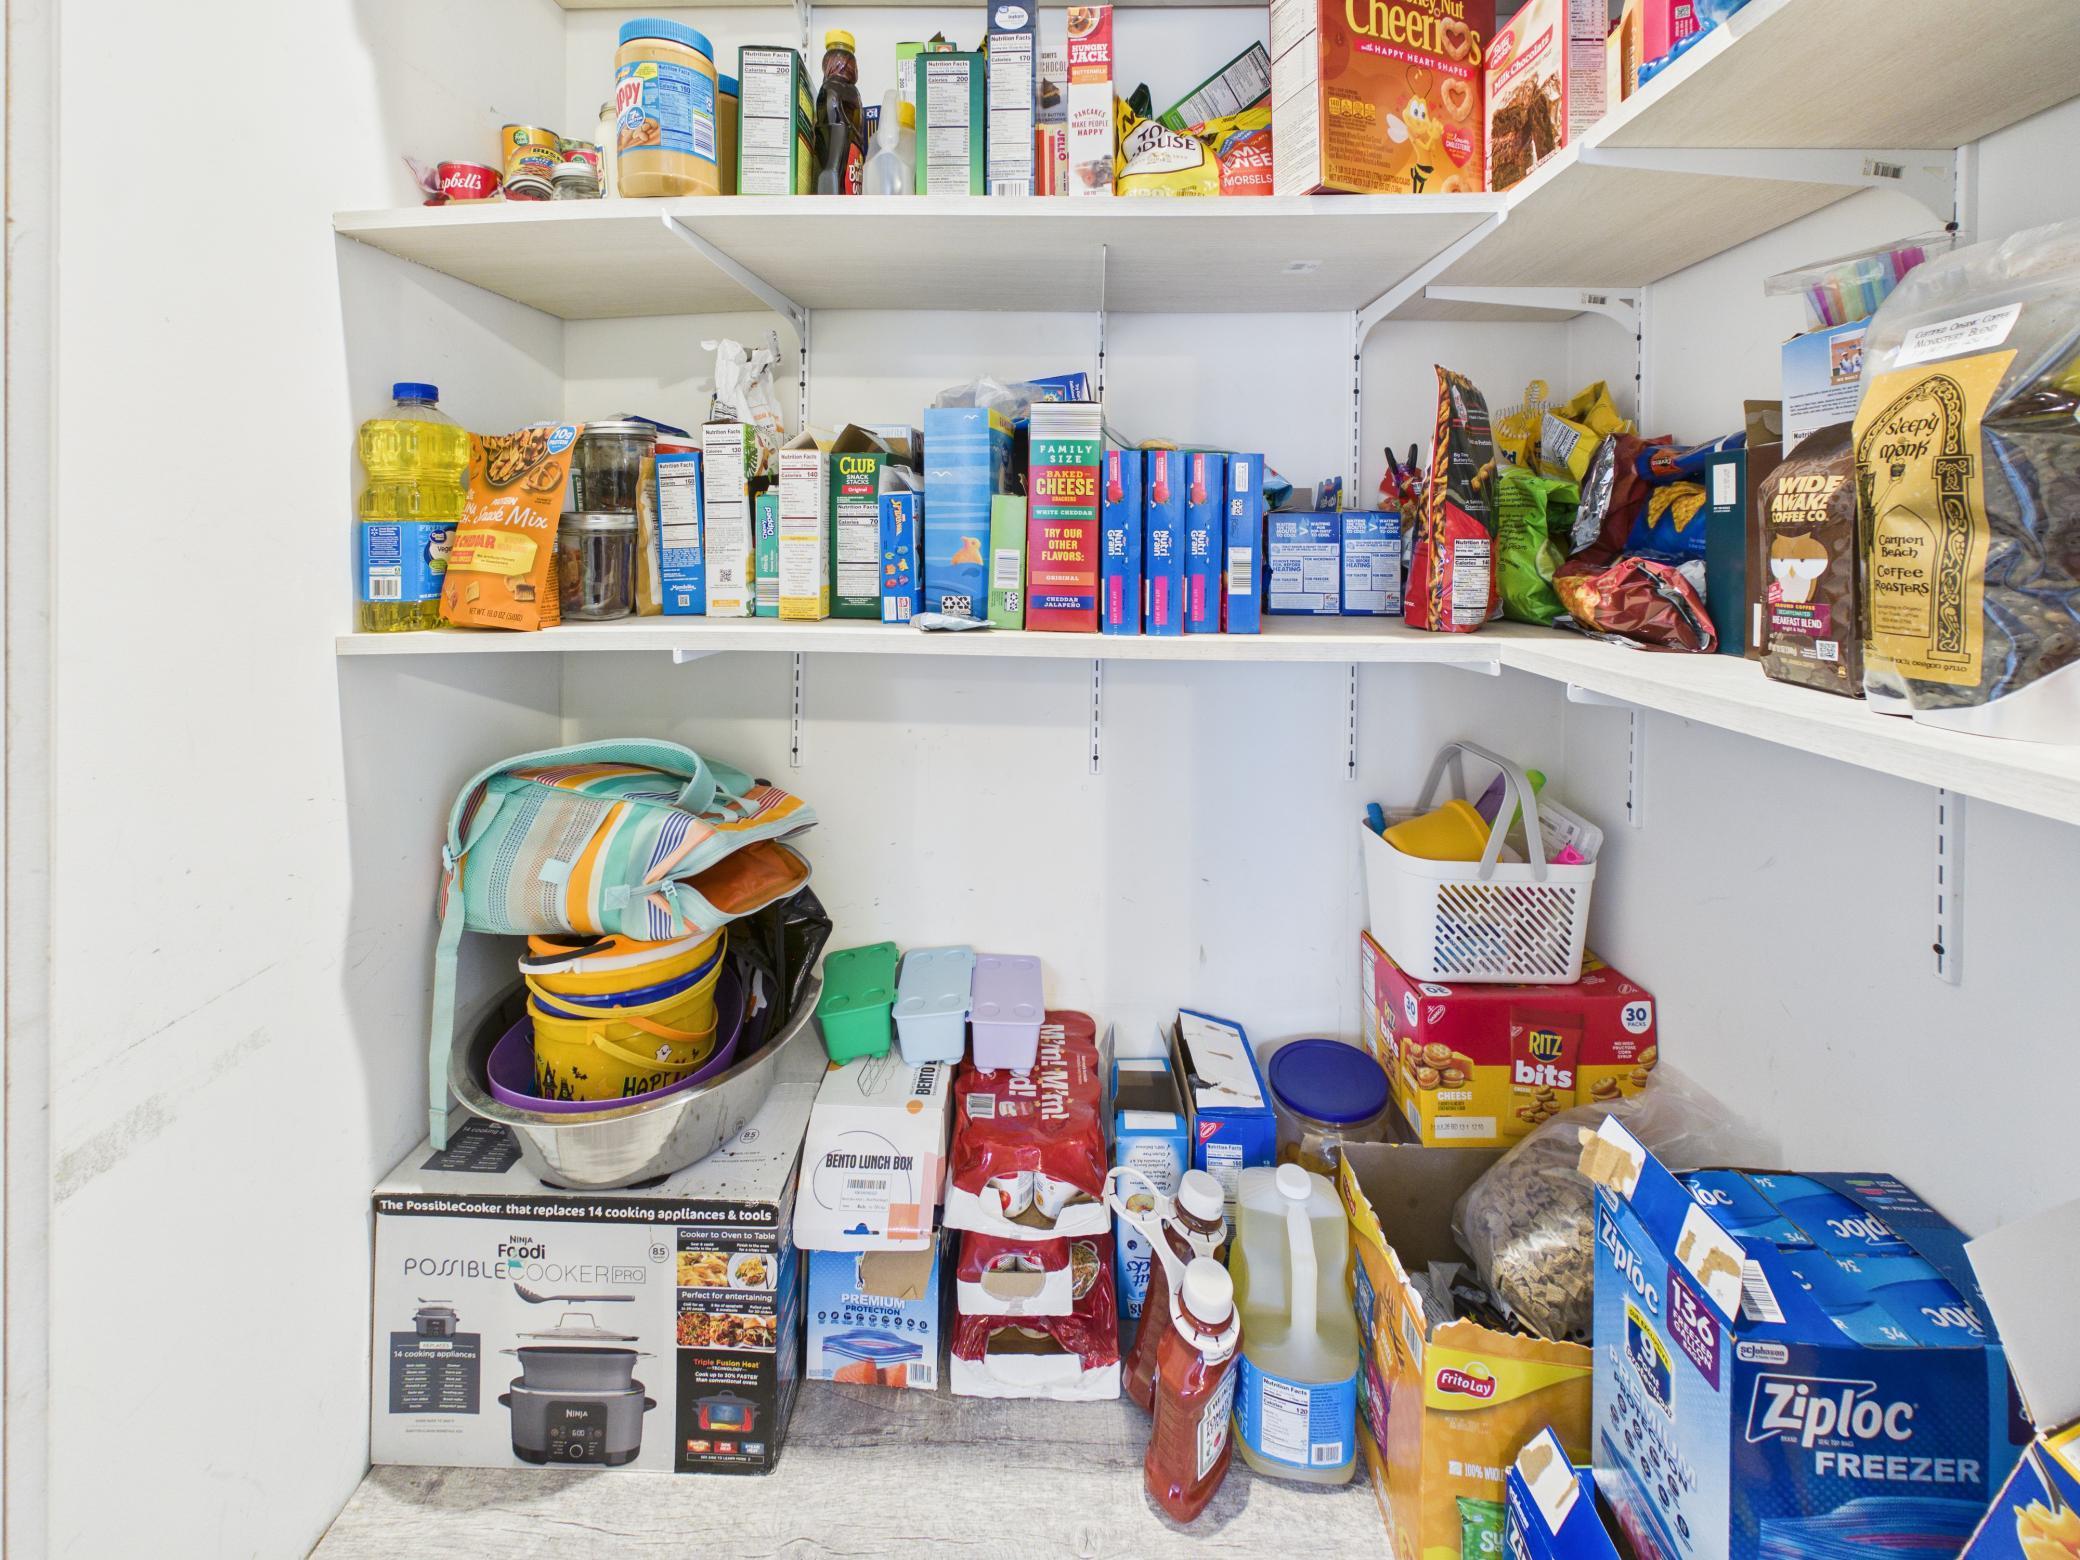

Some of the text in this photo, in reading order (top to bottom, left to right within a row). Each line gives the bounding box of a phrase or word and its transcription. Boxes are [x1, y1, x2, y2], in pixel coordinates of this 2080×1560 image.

[1071, 43, 1107, 52] HUNGRY
[1374, 45, 1468, 77] HAPPY HEART SHAPES
[1494, 70, 1510, 90] Milk
[1088, 120, 1109, 128] PEOPLE
[1223, 174, 1273, 187] MORSELS
[1039, 444, 1093, 455] FAMILY
[839, 456, 876, 475] CLUB
[1050, 455, 1083, 464] SIZE
[1046, 470, 1084, 478] BAKED
[1036, 479, 1095, 496] CHEESE
[1779, 475, 1845, 494] WIDE
[1771, 493, 1833, 512] AWAKE
[505, 505, 548, 529] Mix
[1036, 509, 1093, 517] WHITE CHEDDAR
[1772, 510, 1830, 523] COFFEE CO.
[766, 506, 775, 536] Dipped
[1044, 528, 1083, 539] TRY OUR
[1048, 540, 1078, 551] OTHER
[1041, 551, 1085, 563] FLAVORS:
[1045, 574, 1080, 582] ORIGINAL
[1801, 618, 1823, 629] BLEND
[1626, 1007, 1648, 1021] 30
[1529, 1030, 1563, 1056] RITZ
[915, 1066, 936, 1096] BENTO
[1515, 1060, 1573, 1089] bits
[1437, 1091, 1473, 1101] CHEESE
[826, 1153, 913, 1171] BENTO LUNCH BOX
[380, 1199, 404, 1210] The
[506, 1204, 532, 1215] that
[534, 1206, 585, 1218] replaces
[588, 1206, 603, 1217] 14
[605, 1207, 656, 1221] cooking
[657, 1208, 726, 1223] appliances
[728, 1210, 737, 1221] &
[739, 1210, 773, 1222] tools
[680, 1230, 709, 1239] Cooker
[711, 1231, 720, 1239] to
[721, 1231, 742, 1240] Oven
[754, 1232, 776, 1240] Table
[498, 1244, 547, 1260] Foodi
[652, 1247, 666, 1257] 8.5
[1600, 1210, 1660, 1318] Ziploc
[614, 1268, 645, 1281] PRO
[681, 1291, 773, 1302] Perfect for entertaining
[841, 1293, 906, 1309] PREMIUM
[845, 1304, 901, 1316] PROTECTION
[1672, 1277, 1715, 1347] 136
[393, 1350, 476, 1359] 14 cooking appliances
[694, 1358, 760, 1369] Triple Fusion Heat
[1263, 1377, 1308, 1396] Nutrition Facts
[1263, 1399, 1308, 1415] Calories 120
[1762, 1383, 1914, 1448] Ziploc
[1464, 1463, 1483, 1477] 100%
[1814, 1451, 1982, 1485] FREEZER
